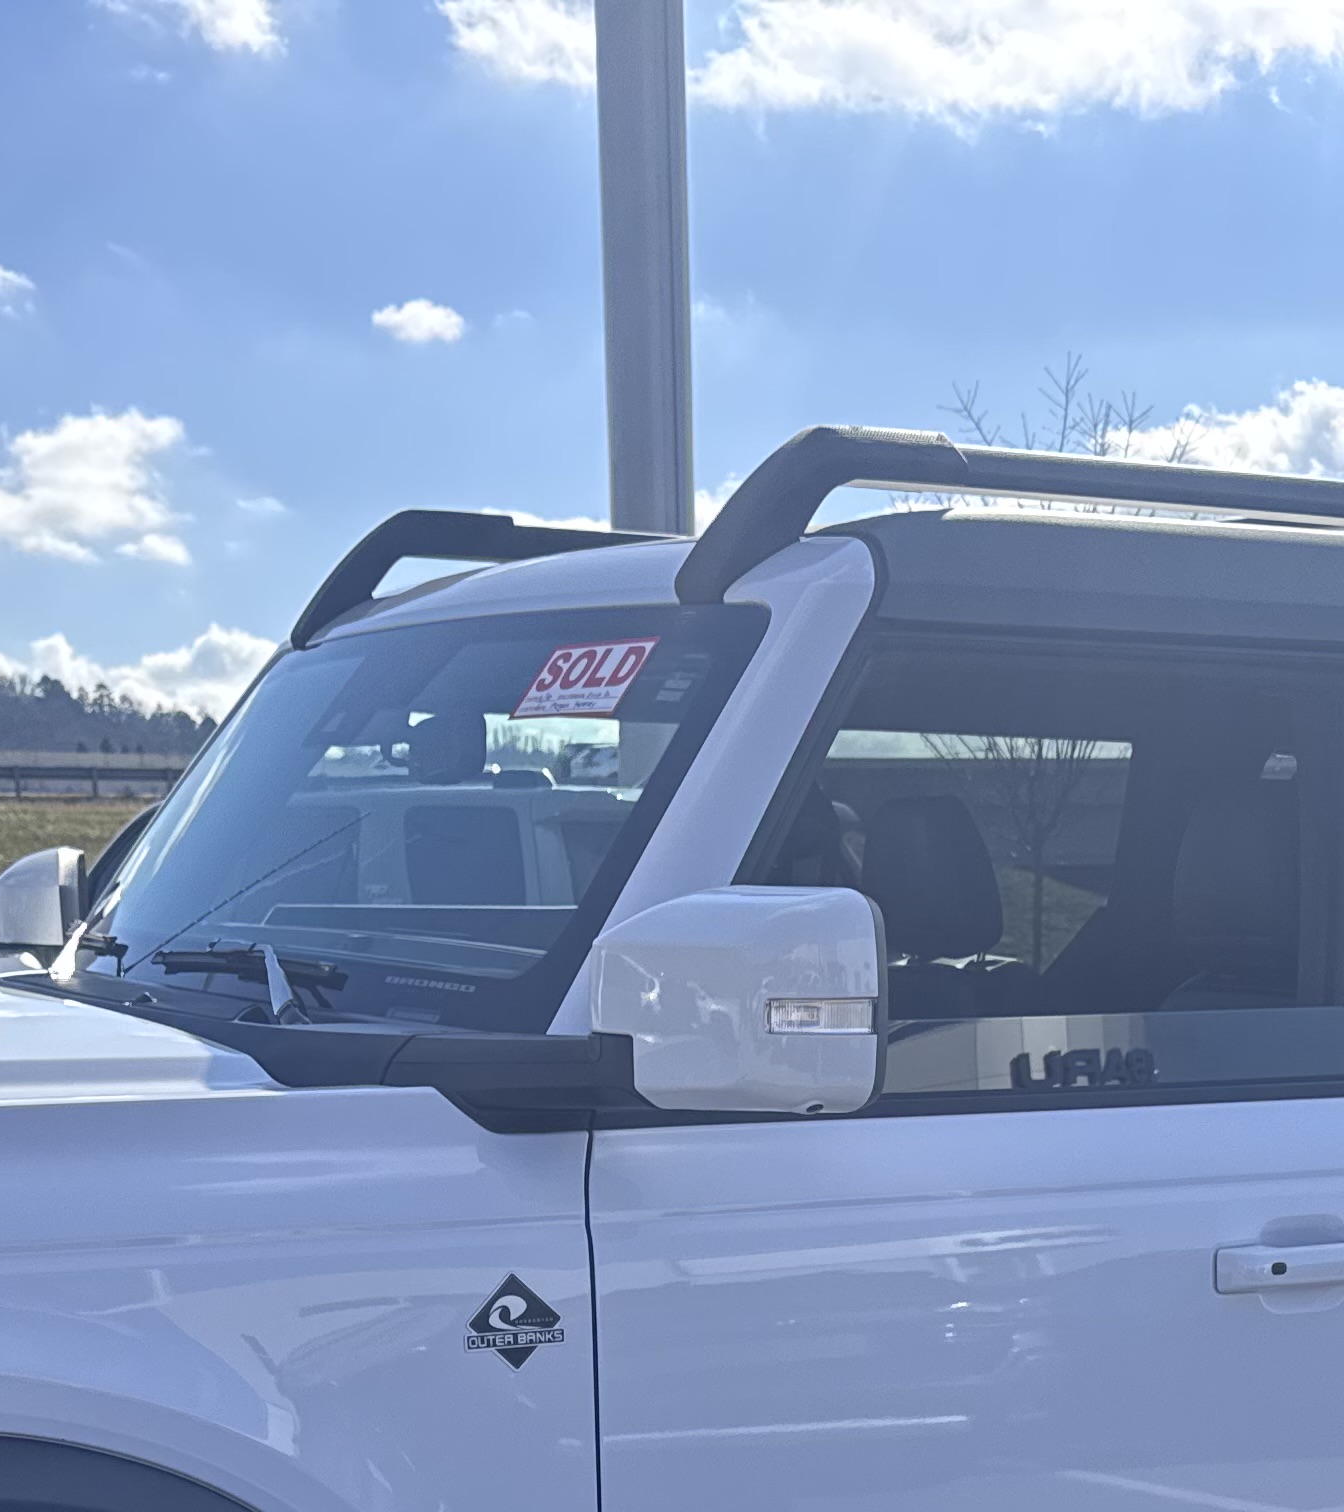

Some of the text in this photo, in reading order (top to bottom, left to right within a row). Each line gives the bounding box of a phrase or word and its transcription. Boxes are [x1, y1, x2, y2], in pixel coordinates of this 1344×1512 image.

[536, 645, 647, 692] SOLD
[468, 1329, 563, 1349] OUTER BANKS
